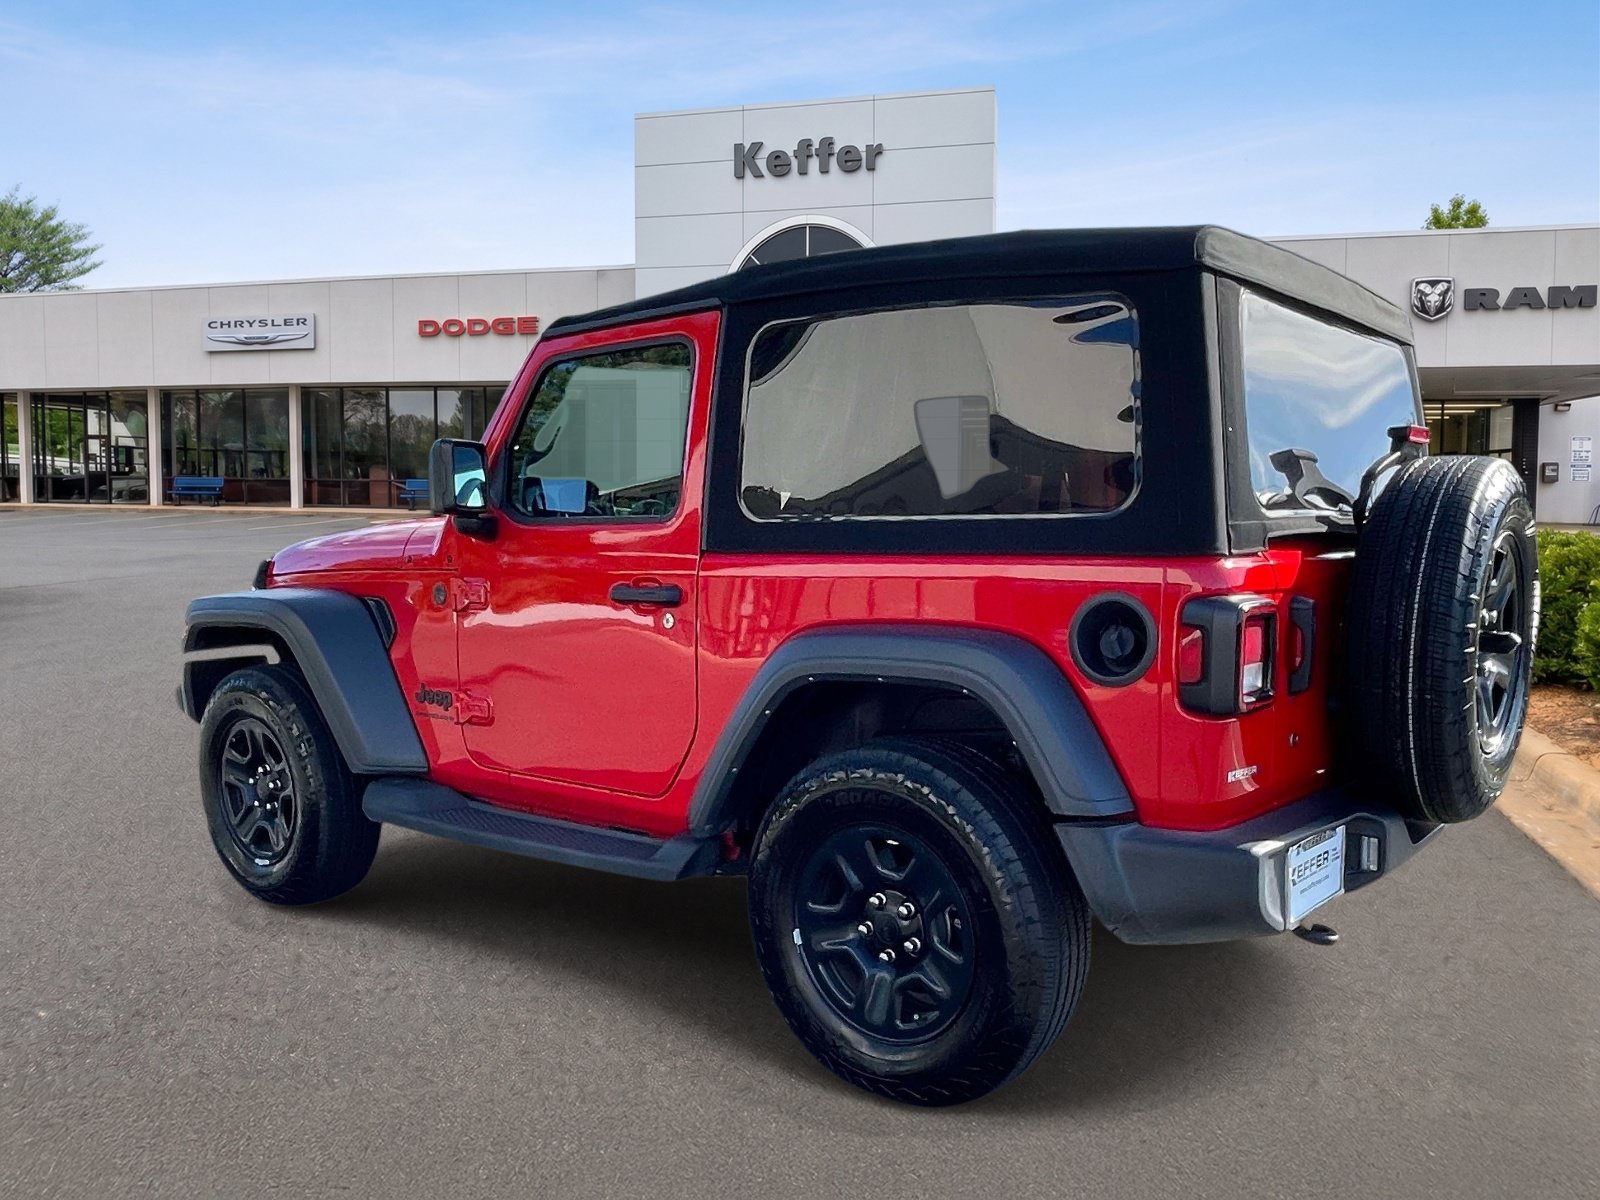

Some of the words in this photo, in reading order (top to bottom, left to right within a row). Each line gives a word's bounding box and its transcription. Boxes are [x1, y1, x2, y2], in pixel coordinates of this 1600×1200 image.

[734, 137, 883, 179] Keffer
[1464, 285, 1598, 311] RAM
[207, 317, 308, 330] CHRYSLER
[418, 316, 539, 337] DODGE
[415, 683, 453, 711] Jeep
